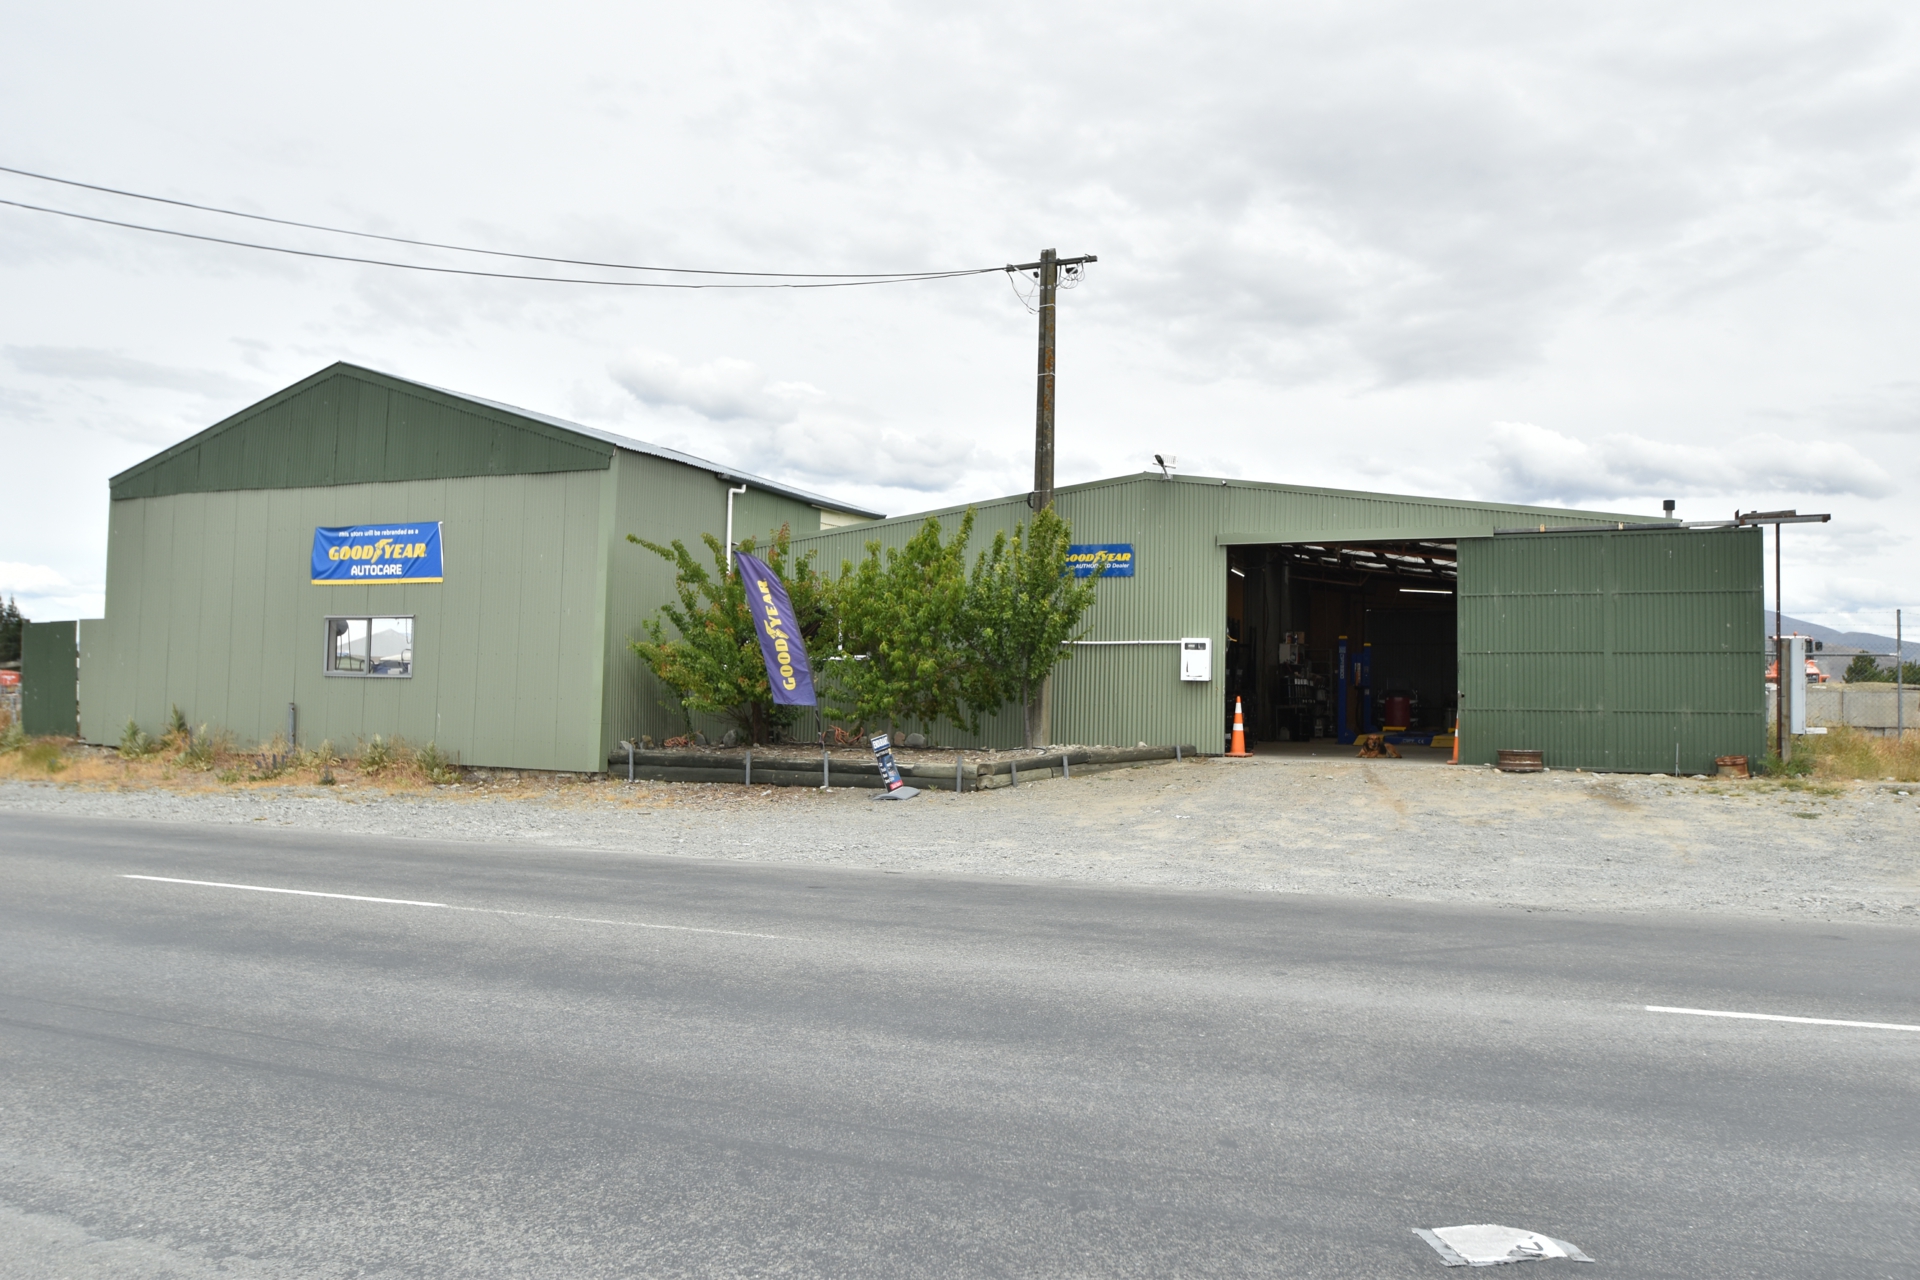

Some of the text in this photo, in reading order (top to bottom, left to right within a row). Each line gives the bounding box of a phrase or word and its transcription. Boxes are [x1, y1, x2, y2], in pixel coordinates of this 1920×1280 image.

[328, 539, 427, 564] GOODYEAR
[350, 564, 402, 576] AUTOCARE
[757, 580, 796, 690] GOODYEAR
